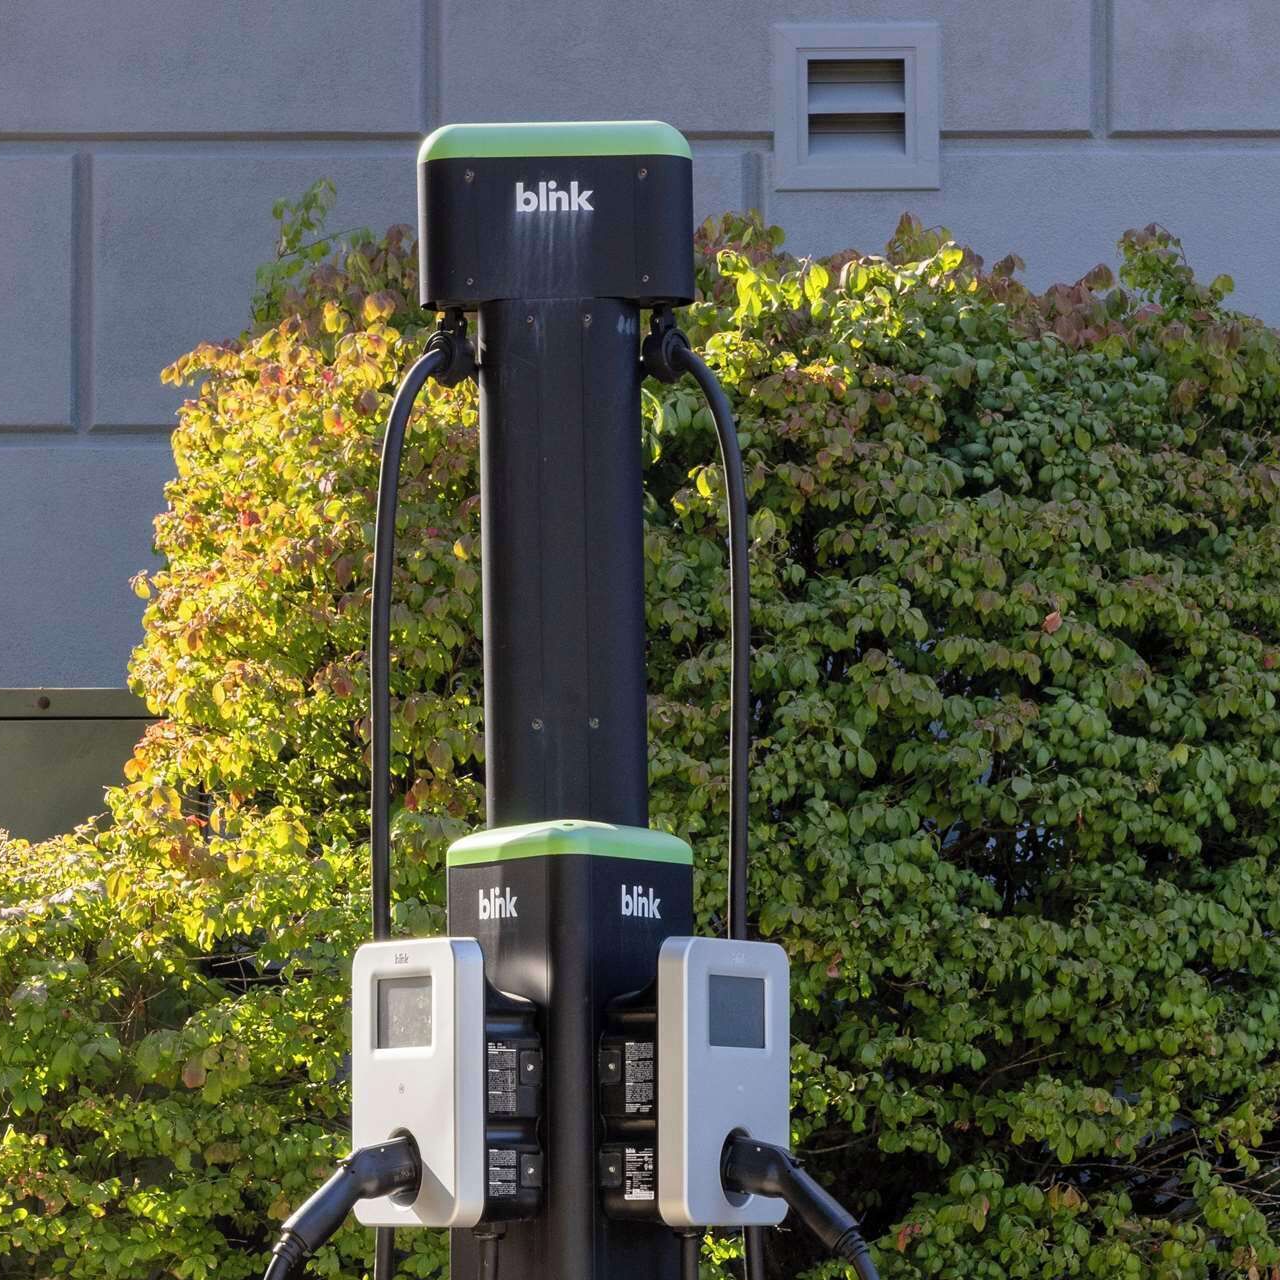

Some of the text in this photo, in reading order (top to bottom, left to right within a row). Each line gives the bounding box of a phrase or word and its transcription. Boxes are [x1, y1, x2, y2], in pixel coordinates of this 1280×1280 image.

[515, 180, 594, 213] blink
[478, 887, 518, 920] blink
[621, 884, 661, 919] blink
